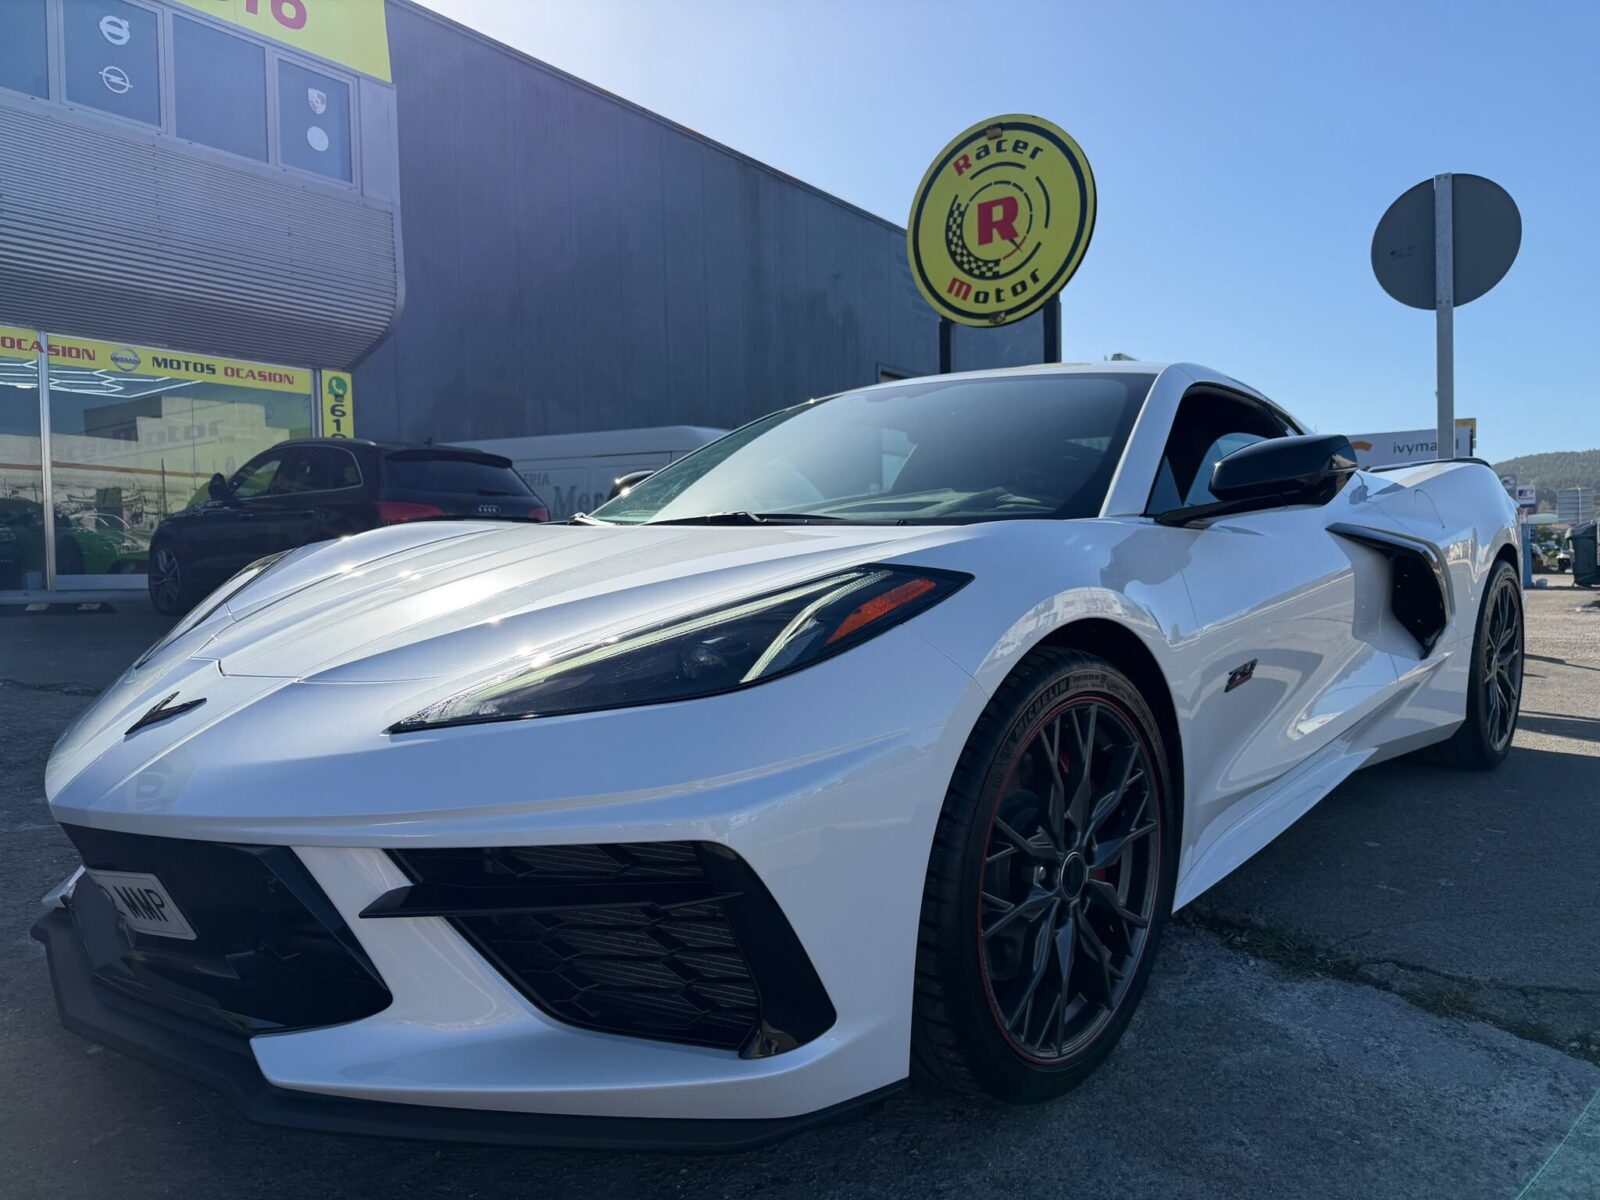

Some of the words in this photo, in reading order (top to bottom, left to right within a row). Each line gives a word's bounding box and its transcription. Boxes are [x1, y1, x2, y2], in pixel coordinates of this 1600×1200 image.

[952, 138, 1044, 177] Racer
[977, 195, 1021, 247] R
[946, 267, 1042, 305] Motor
[0, 335, 96, 362] OCASION
[152, 356, 217, 376] MOTOS
[223, 365, 295, 386] OCASION
[329, 403, 348, 439] 61
[112, 885, 169, 923] MMP
